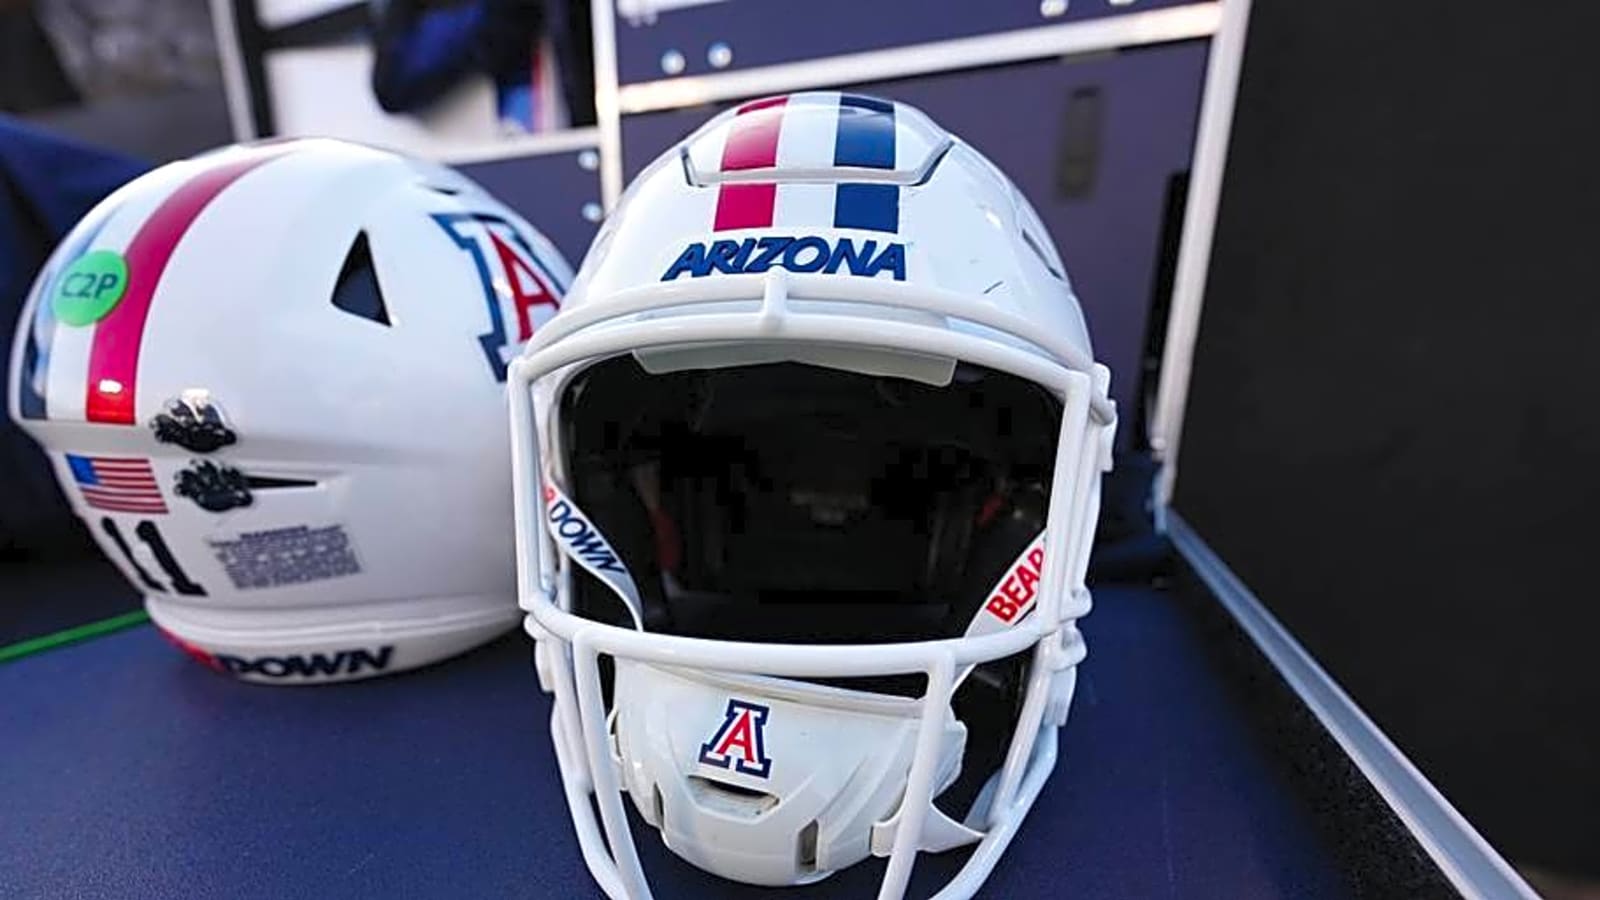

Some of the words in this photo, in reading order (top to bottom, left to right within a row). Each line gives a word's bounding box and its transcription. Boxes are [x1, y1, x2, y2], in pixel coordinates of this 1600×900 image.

[61, 272, 118, 299] C2P
[660, 236, 906, 281] ARIZONA
[101, 517, 208, 597] 11
[549, 500, 626, 574] DOWN
[219, 645, 395, 677] DOWN
[698, 698, 772, 779] A
